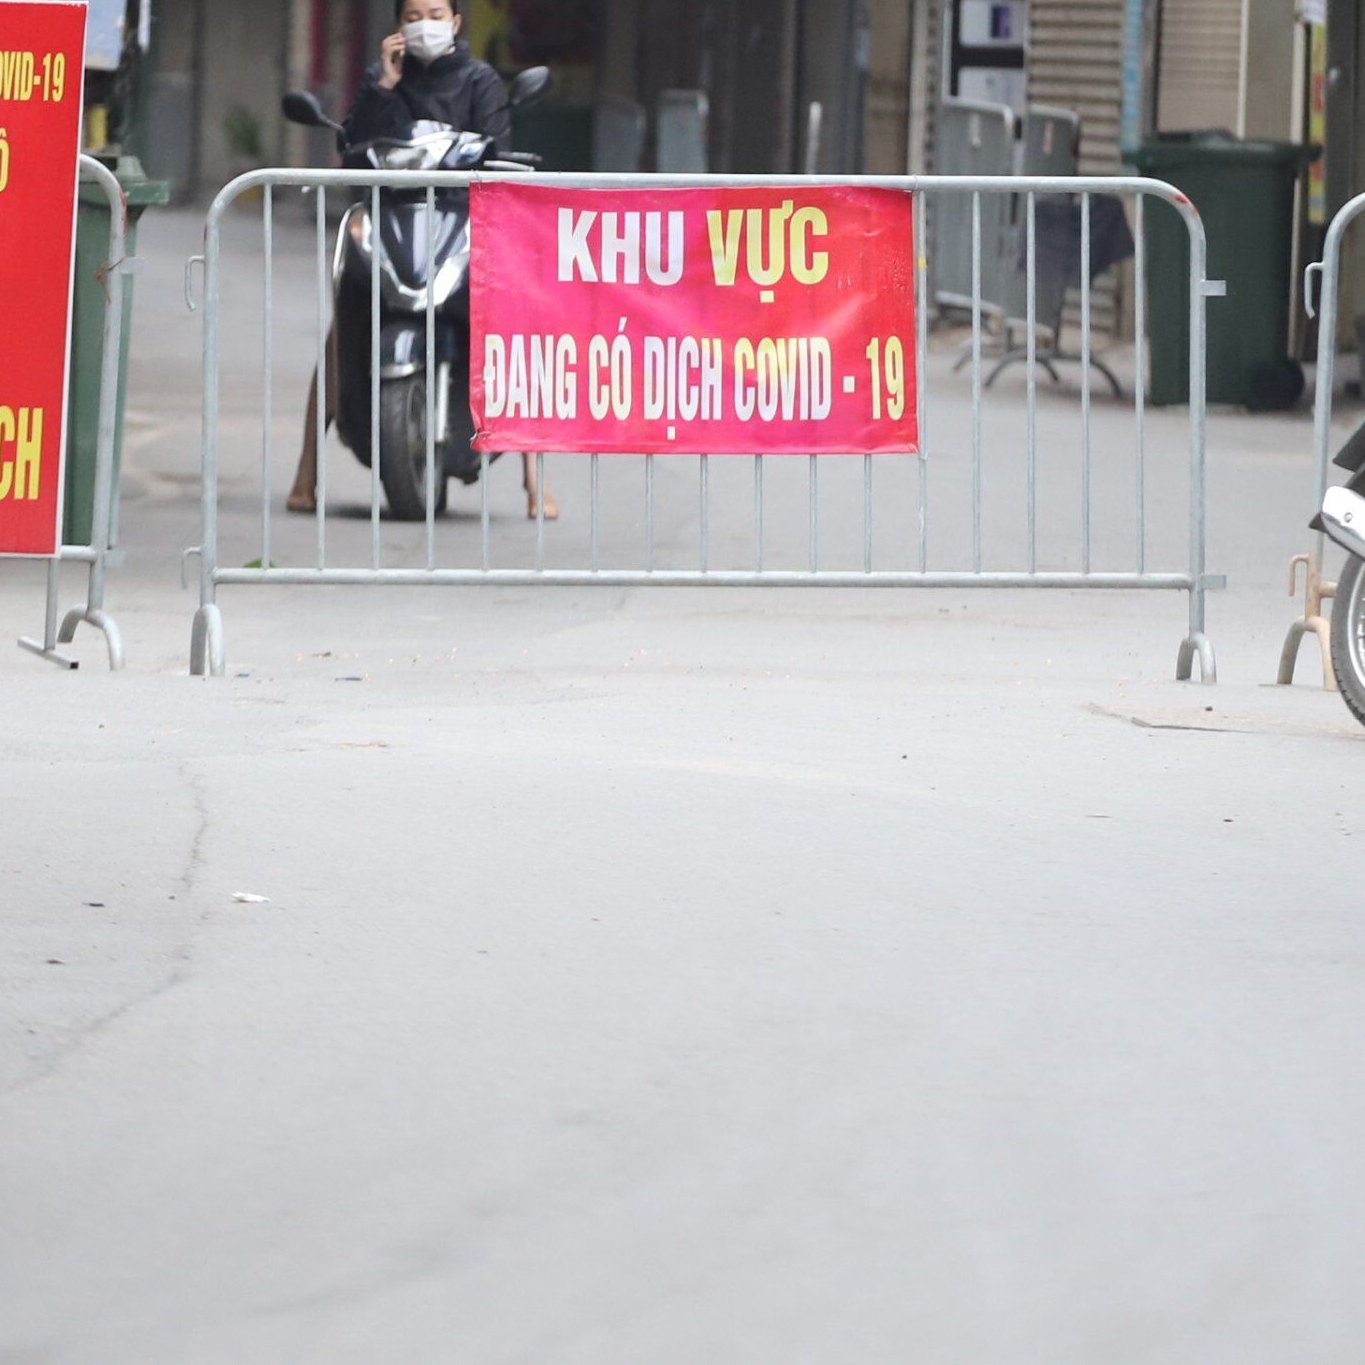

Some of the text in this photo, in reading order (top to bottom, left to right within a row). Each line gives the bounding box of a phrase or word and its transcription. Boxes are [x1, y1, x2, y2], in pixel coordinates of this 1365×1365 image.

[557, 200, 829, 303] KHU VỰC
[483, 333, 577, 419] ĐANG
[588, 316, 632, 421] CÓ
[643, 335, 722, 440] DỊCH
[734, 335, 832, 422] COVID
[865, 335, 904, 421] 19
